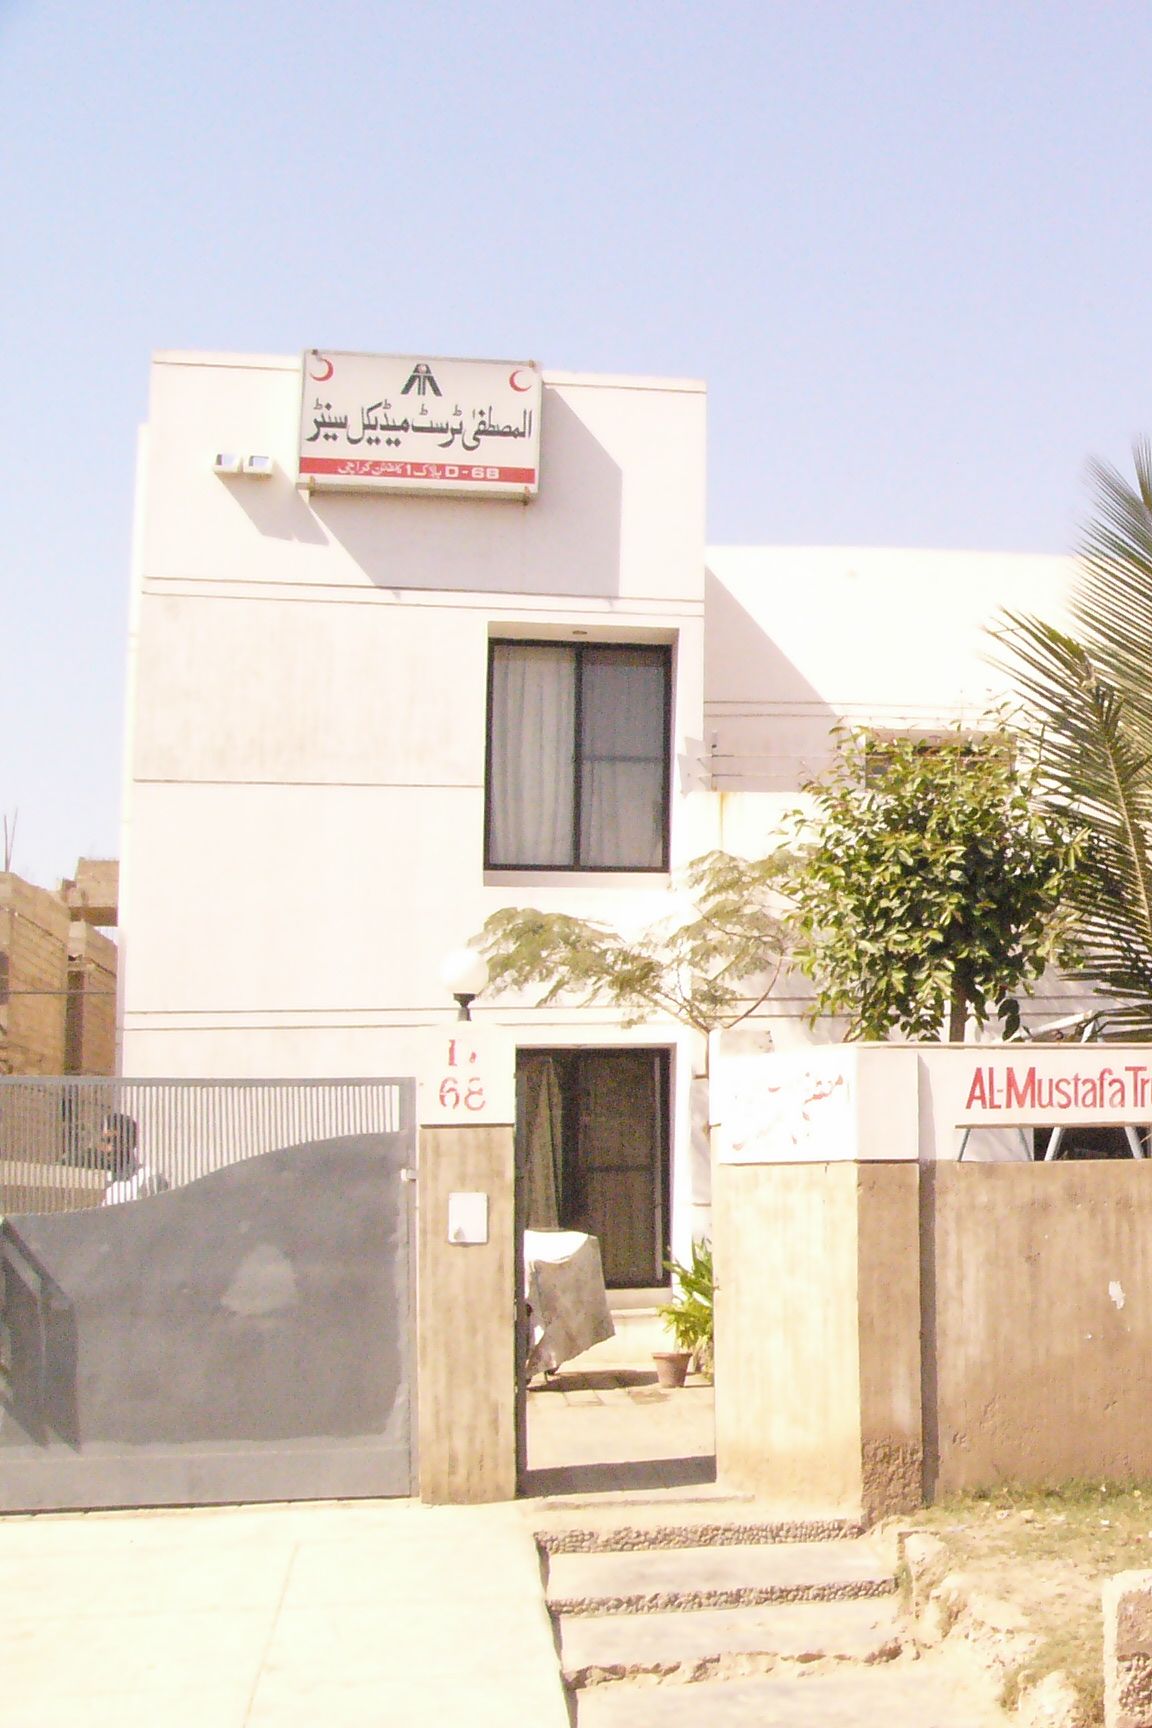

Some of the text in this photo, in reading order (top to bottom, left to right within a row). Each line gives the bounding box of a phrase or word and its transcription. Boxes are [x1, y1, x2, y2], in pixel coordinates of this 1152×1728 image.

[346, 398, 410, 447] میڈیکل
[411, 403, 463, 448] ٹرسٹ
[439, 1076, 486, 1111] 68
